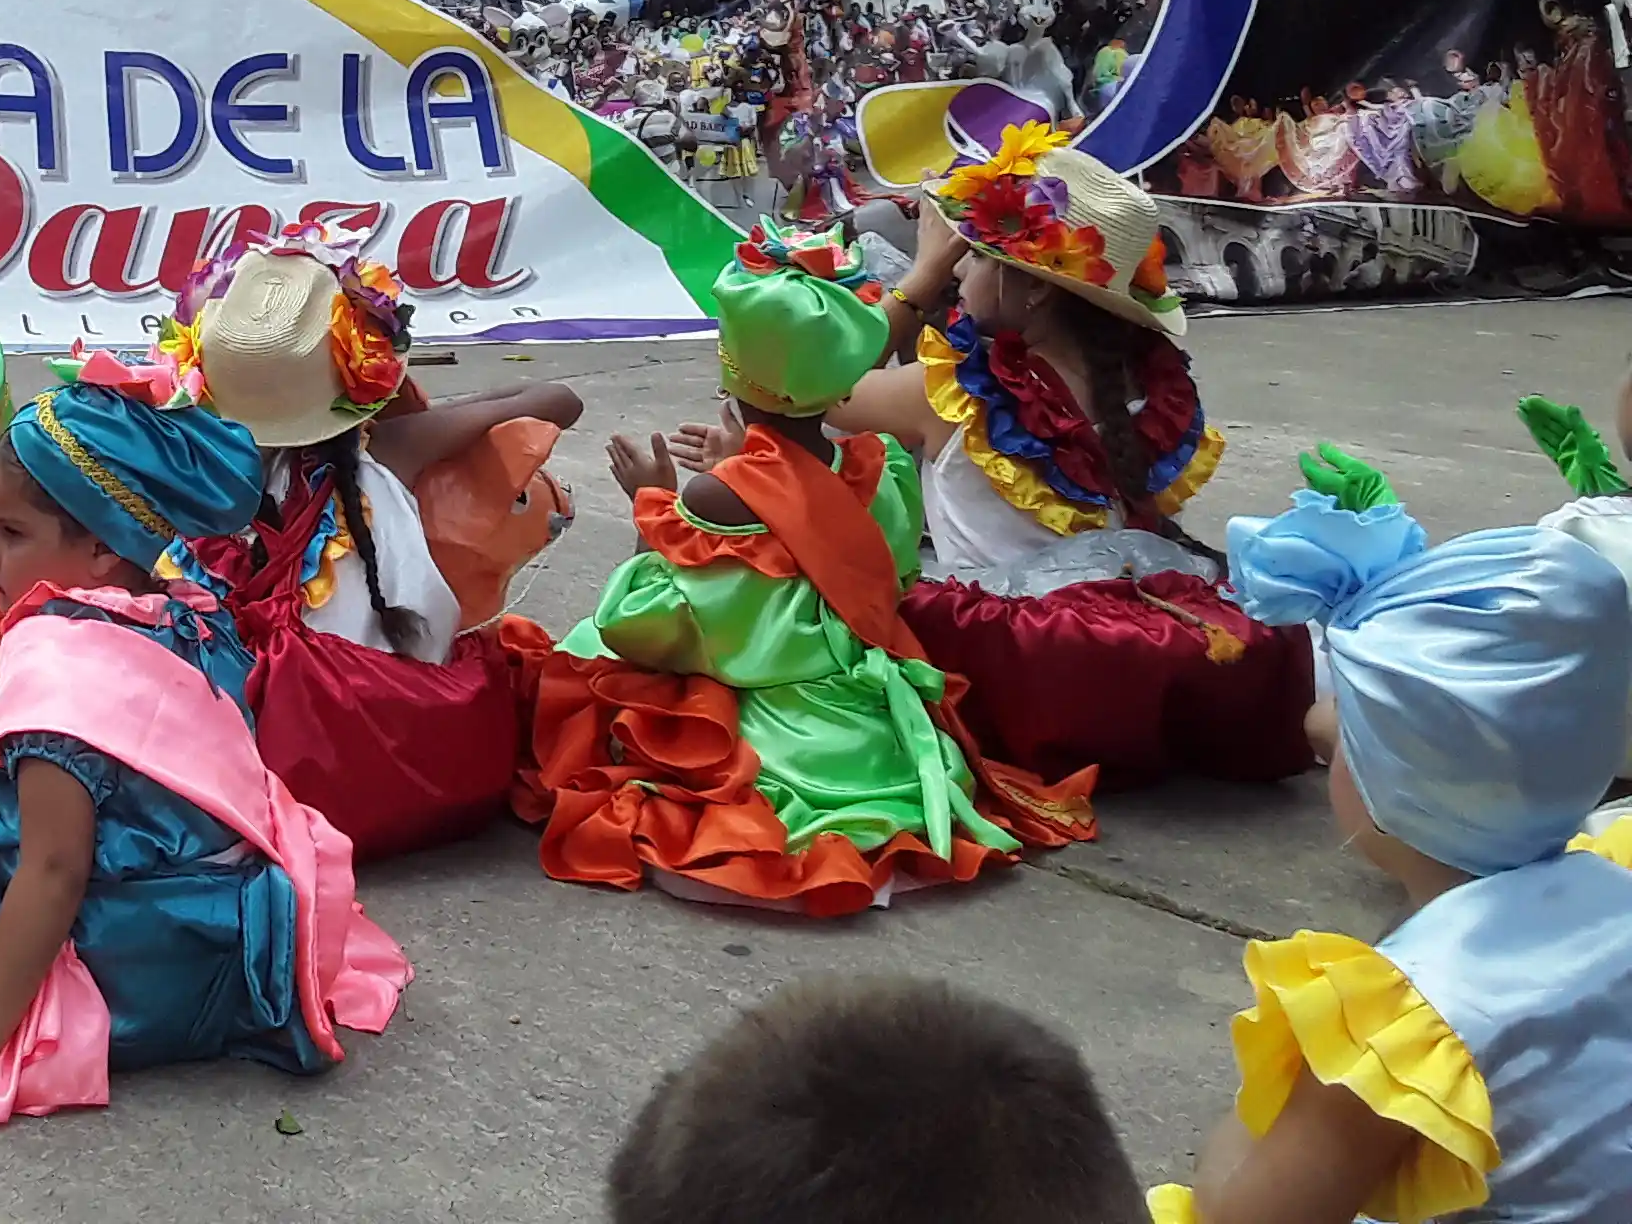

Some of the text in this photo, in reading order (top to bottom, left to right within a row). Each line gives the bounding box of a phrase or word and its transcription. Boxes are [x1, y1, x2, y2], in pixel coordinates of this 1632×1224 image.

[103, 49, 298, 174] DE
[341, 51, 502, 172] LA
[21, 313, 163, 336] LLA
